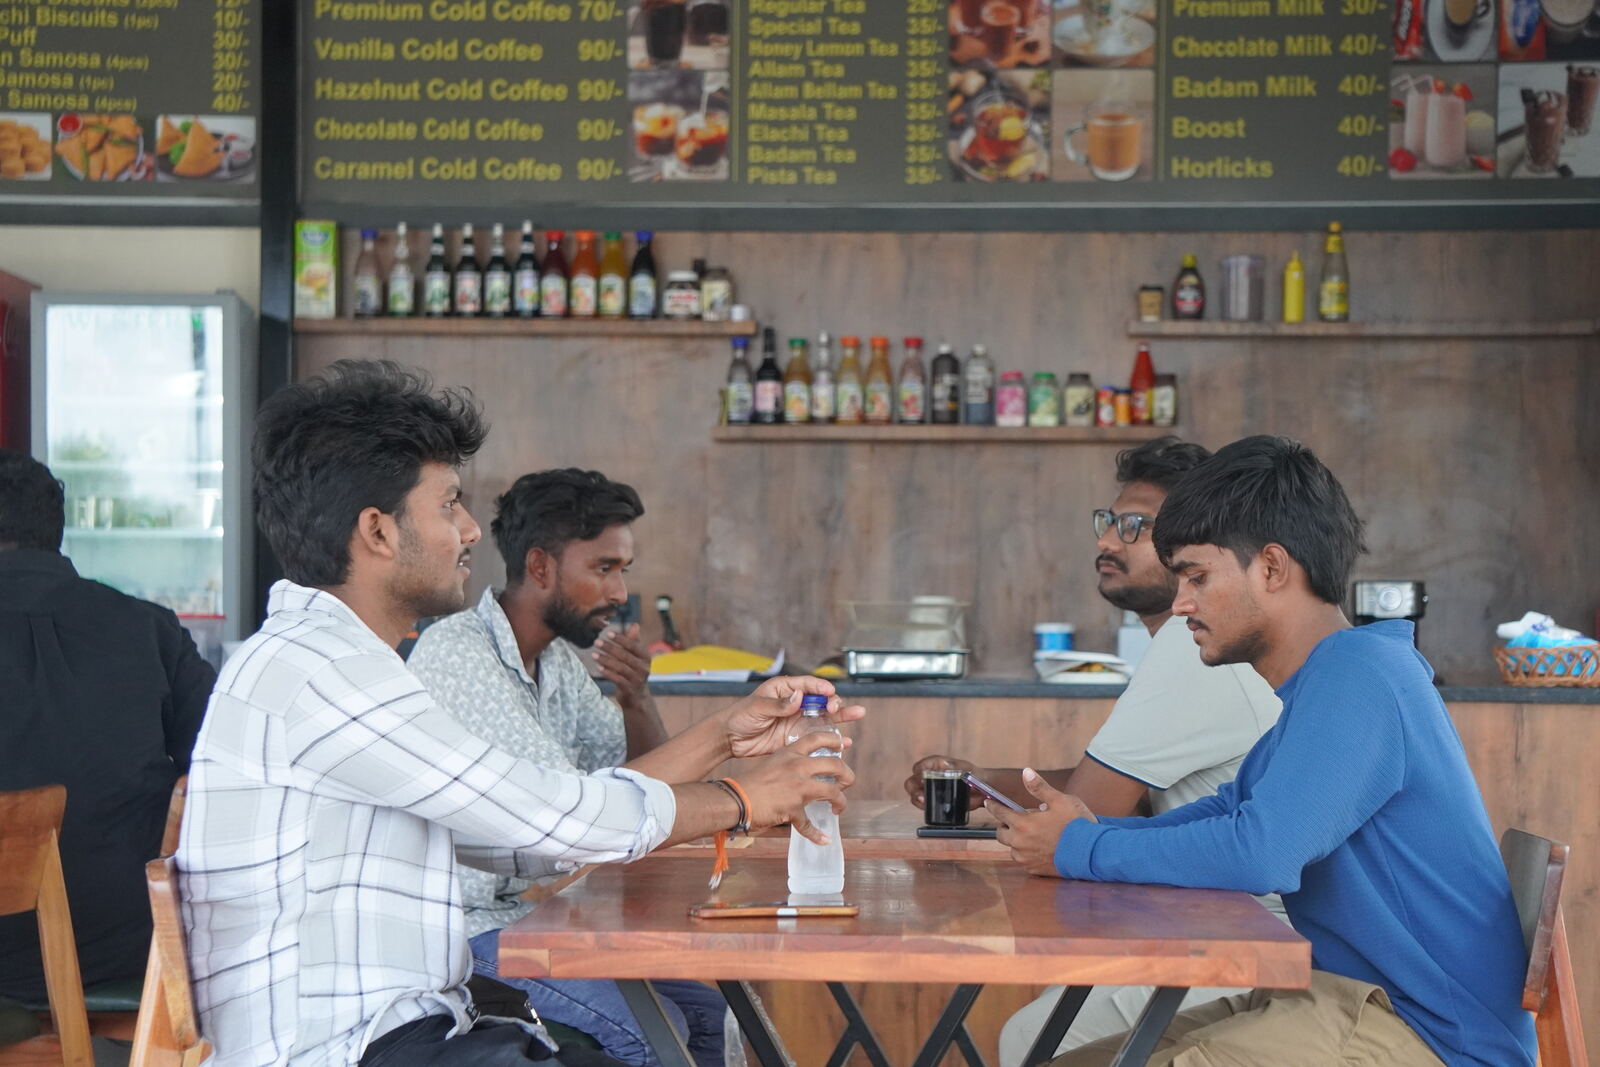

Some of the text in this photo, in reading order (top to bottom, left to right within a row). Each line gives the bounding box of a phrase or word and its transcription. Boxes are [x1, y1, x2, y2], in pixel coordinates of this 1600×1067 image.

[35, 5, 120, 27] Biscuits
[214, 7, 249, 30] 10/-
[314, 0, 624, 21] Premium Cold Coffee 70/-
[748, 0, 828, 17] Regular
[832, 0, 867, 14] Tea
[1172, 0, 1271, 16] Premium
[1277, 0, 1324, 15] Milk
[748, 16, 823, 38] Special
[826, 16, 862, 35] Tea
[18, 46, 102, 68] Samosa
[314, 38, 624, 61] Vanilla Cold Coffee 90/-
[748, 39, 804, 62] Honey
[804, 40, 866, 56] Lemon
[866, 38, 900, 56] Tea
[1171, 34, 1387, 58] Chocolate Milk 40/-
[747, 59, 806, 78] Allam
[810, 58, 845, 78] Tea
[212, 71, 249, 92] 20/-
[314, 77, 624, 101] Hazelnut Cold Coffee 90/-
[866, 80, 899, 99] Tea
[1172, 75, 1386, 98] Badam Milk 40/-
[7, 88, 90, 109] Samosa
[211, 92, 249, 112] 40/-
[822, 101, 858, 120] Tea
[313, 117, 624, 141] Chocolate Cold Coffee 90/-
[813, 123, 849, 142] Tea
[1170, 115, 1385, 138] Boost 40/-
[746, 144, 818, 163] Badam
[821, 144, 857, 163] Tea
[314, 157, 624, 181] Caramel Cold Coffee 90/-
[803, 166, 837, 184] Tea
[1171, 156, 1385, 177] Horlicks 40/-
